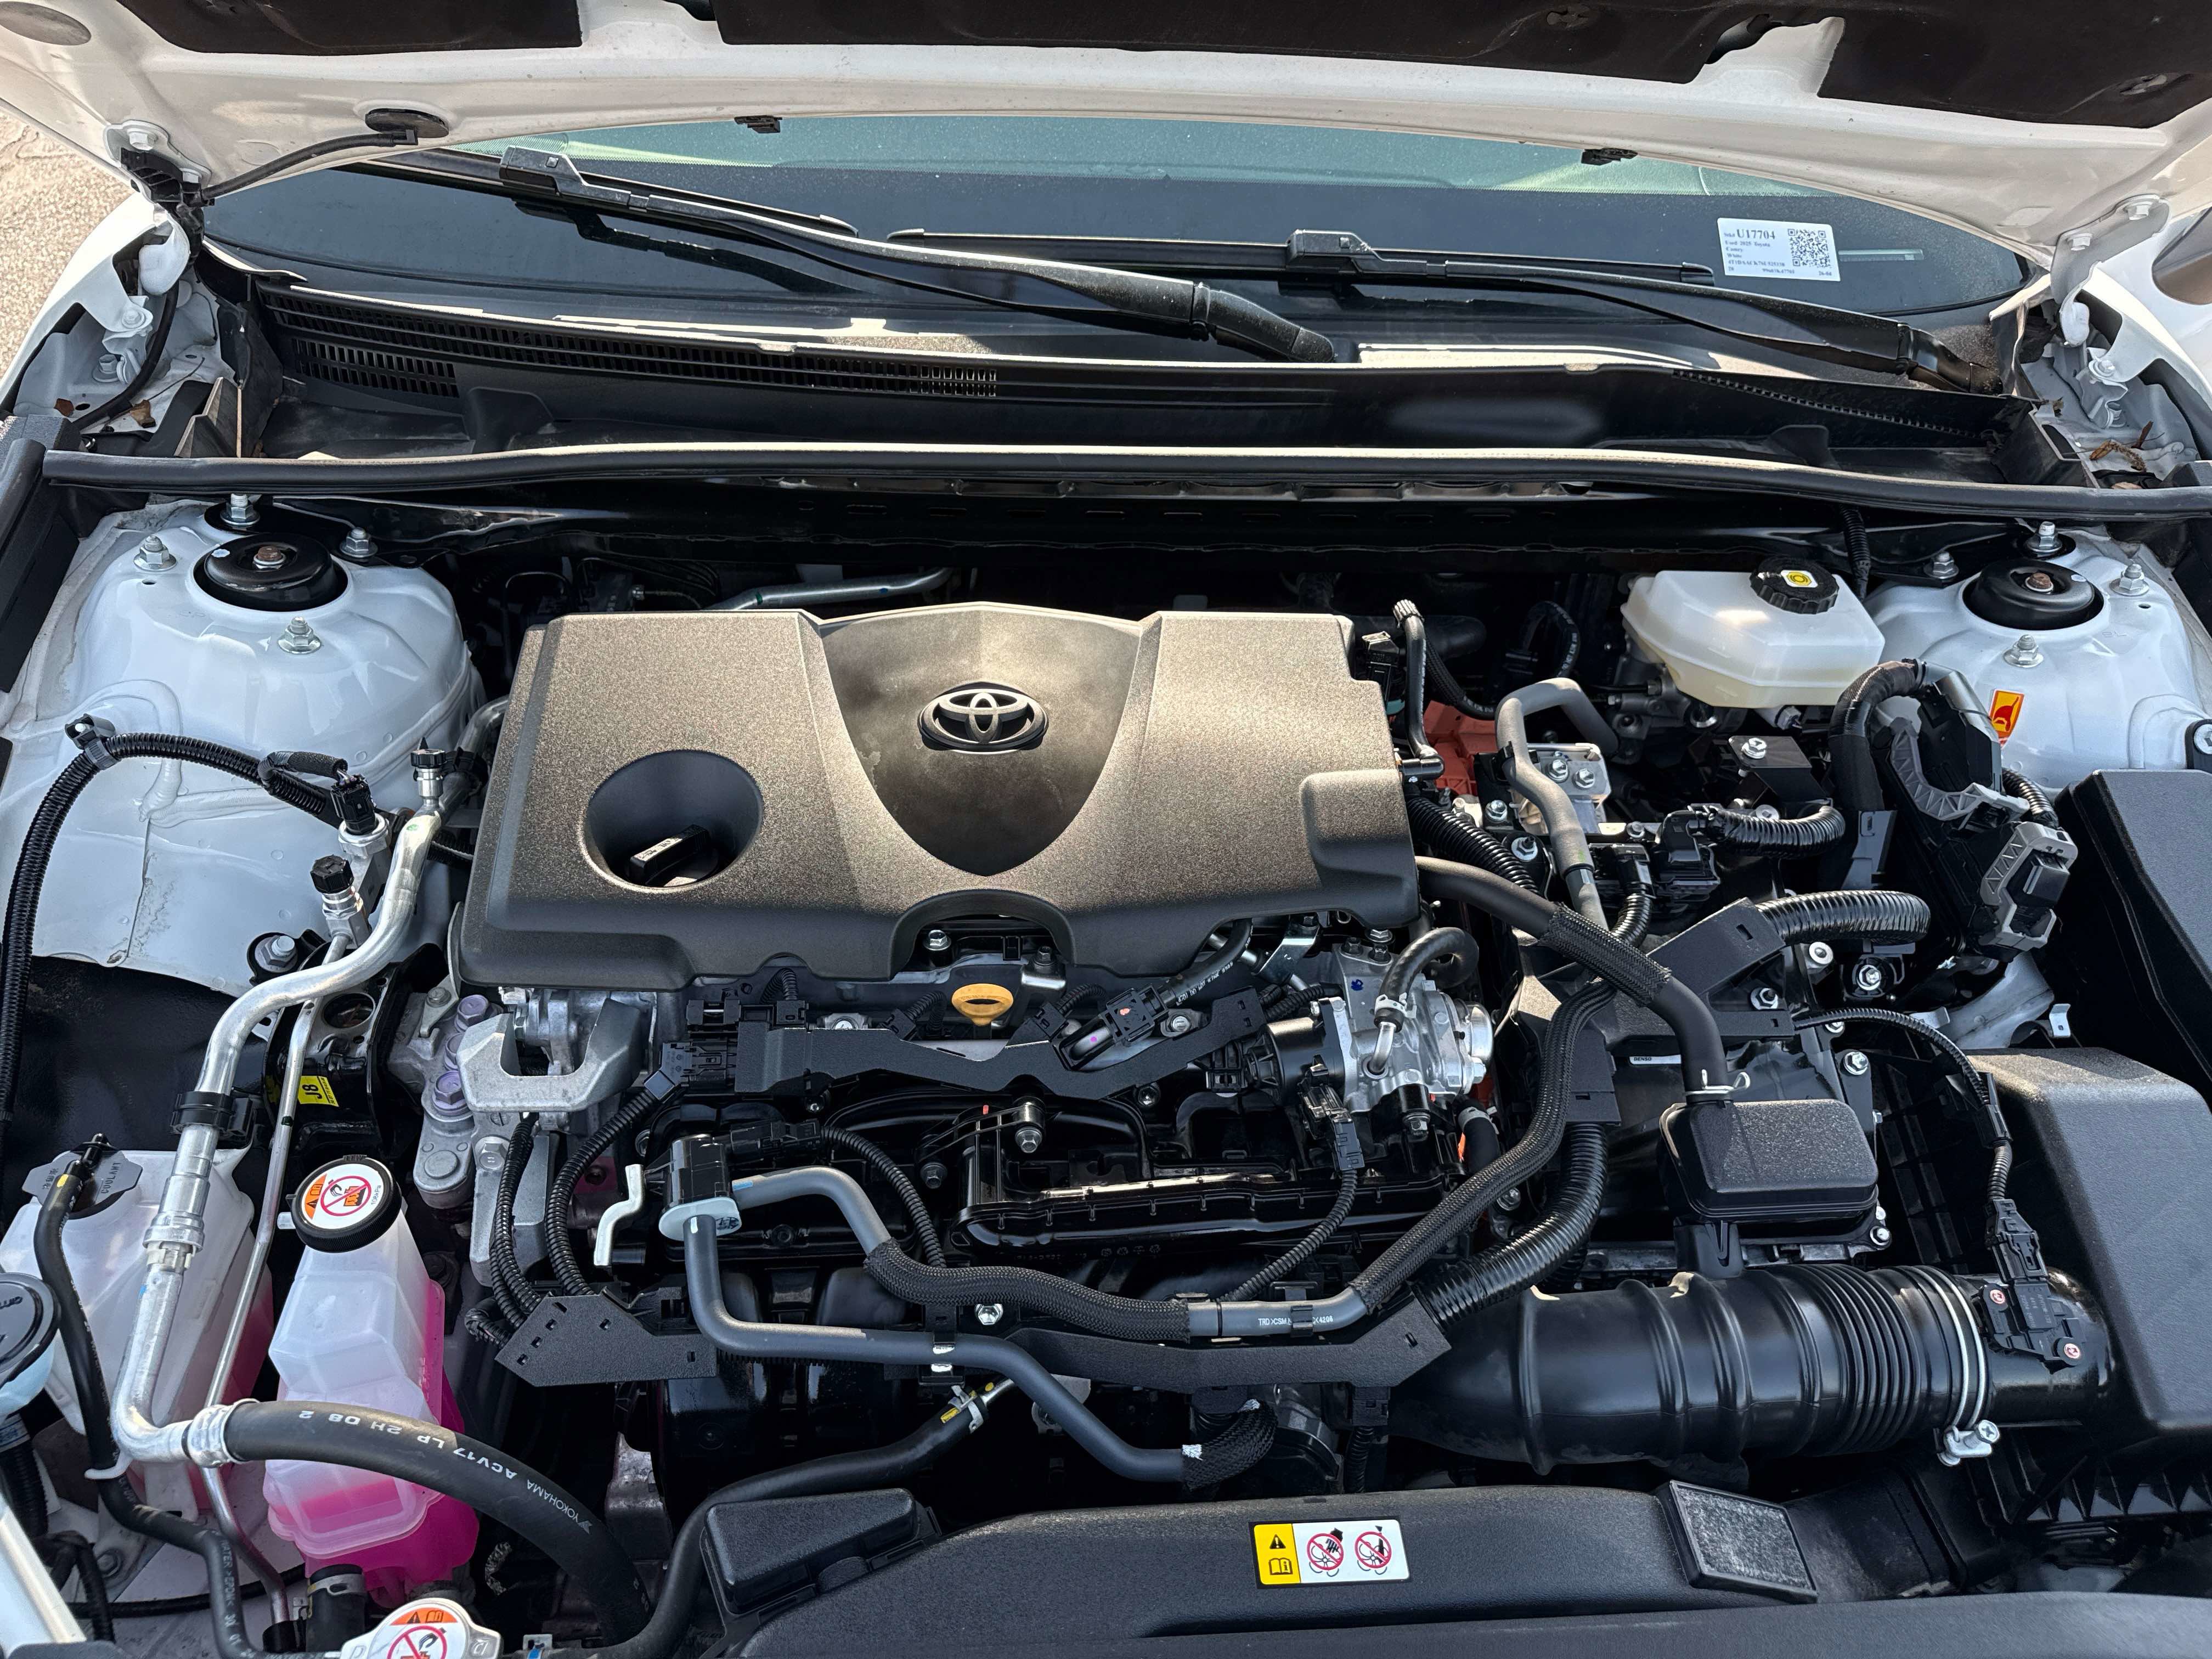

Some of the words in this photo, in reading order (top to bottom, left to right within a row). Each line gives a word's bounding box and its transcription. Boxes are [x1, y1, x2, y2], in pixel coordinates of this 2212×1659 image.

[1737, 229, 1775, 240] U17704
[302, 1084, 323, 1099] J8
[100, 1162, 121, 1194] COOLANT
[299, 1410, 315, 1419] 2
[370, 1420, 402, 1435] 2H
[417, 1434, 445, 1449] LP
[453, 1447, 518, 1480] ACV17
[526, 1479, 582, 1524] YOKOHAMA
